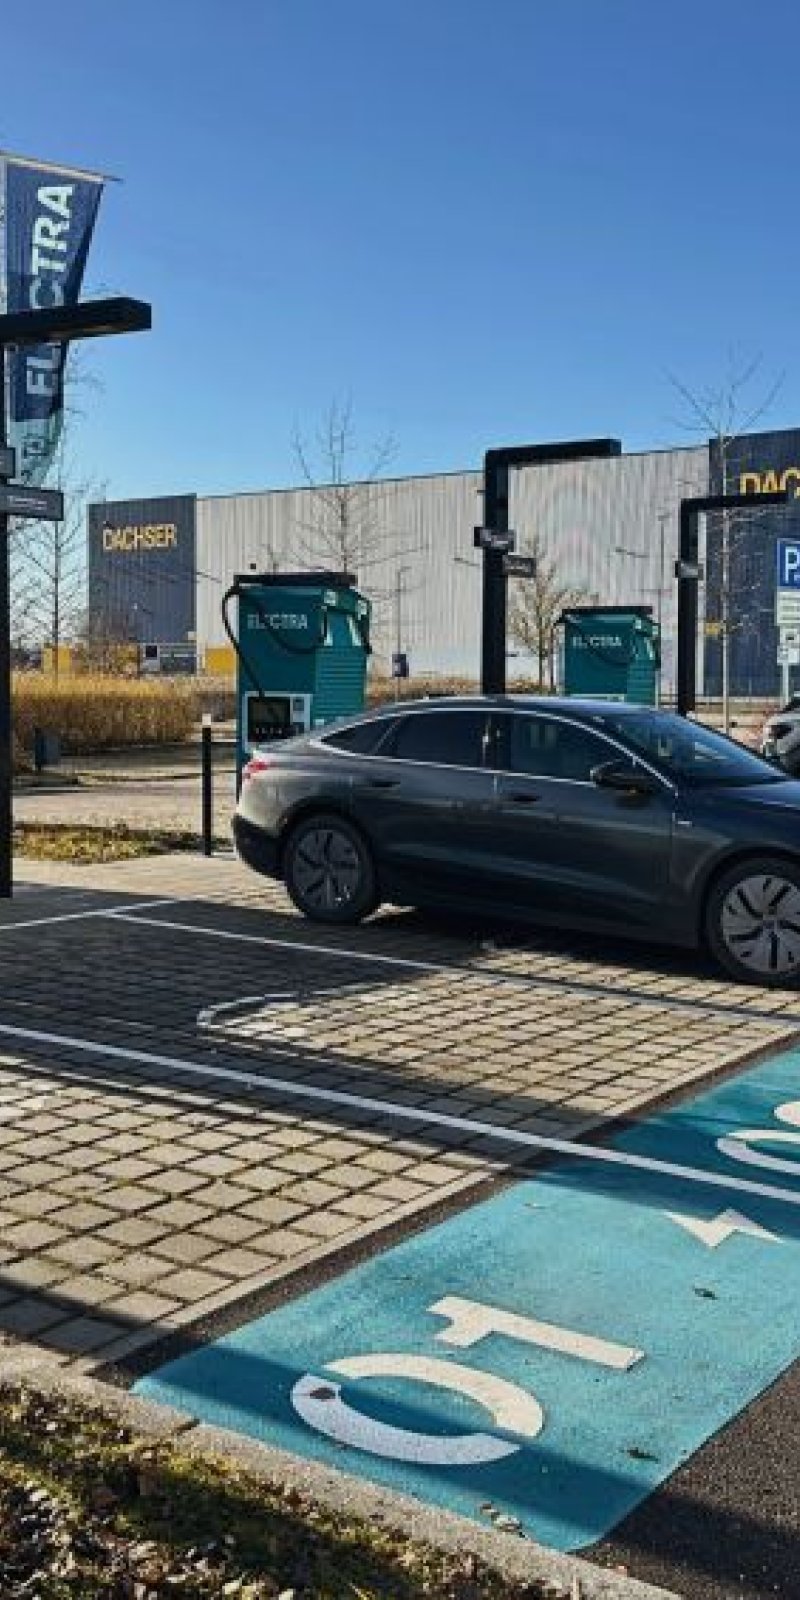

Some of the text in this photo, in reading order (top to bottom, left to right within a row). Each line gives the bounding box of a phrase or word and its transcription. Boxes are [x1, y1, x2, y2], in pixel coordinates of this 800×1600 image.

[26, 184, 73, 397] ELCTRA
[103, 523, 177, 552] DACHSER
[291, 1296, 645, 1466] 01
